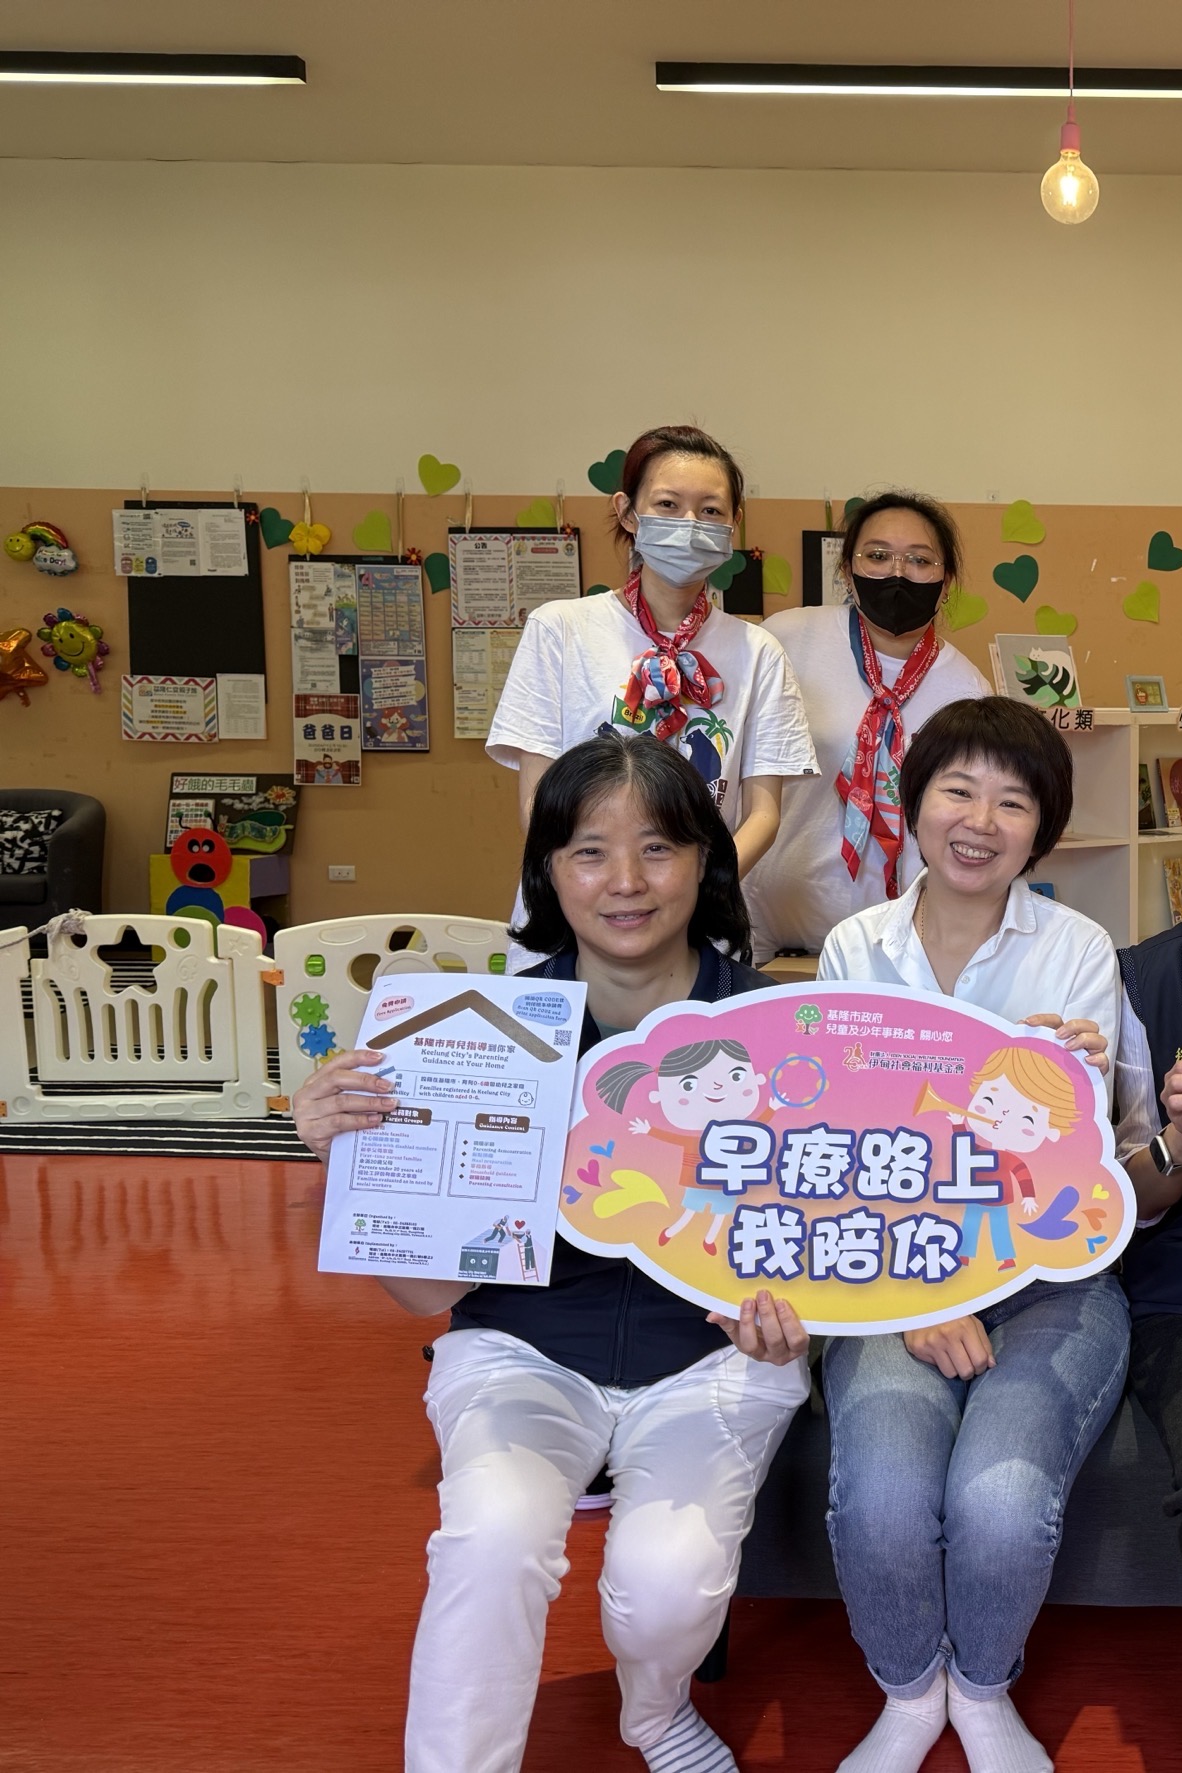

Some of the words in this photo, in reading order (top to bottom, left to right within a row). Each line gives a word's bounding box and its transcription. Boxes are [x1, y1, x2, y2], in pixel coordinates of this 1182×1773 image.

[624, 709, 644, 722] Brzil
[303, 723, 352, 740] 爸爸日
[174, 778, 254, 792] 好餓的毛毛蟲
[382, 998, 406, 1008] 免費申請
[827, 1009, 883, 1024] 基隆市政府
[826, 1023, 914, 1040] 兒童及少年事務處
[414, 1037, 516, 1053] 基隆市育兒指導到你家
[421, 1049, 449, 1058] Keelung
[474, 1053, 509, 1062] Parenting
[422, 1057, 456, 1065] Guidance
[466, 1060, 483, 1068] Your
[869, 1059, 964, 1074] 伊甸社會福利基金會
[698, 1120, 1003, 1202] 早療路上
[729, 1205, 963, 1281] 我陪你
